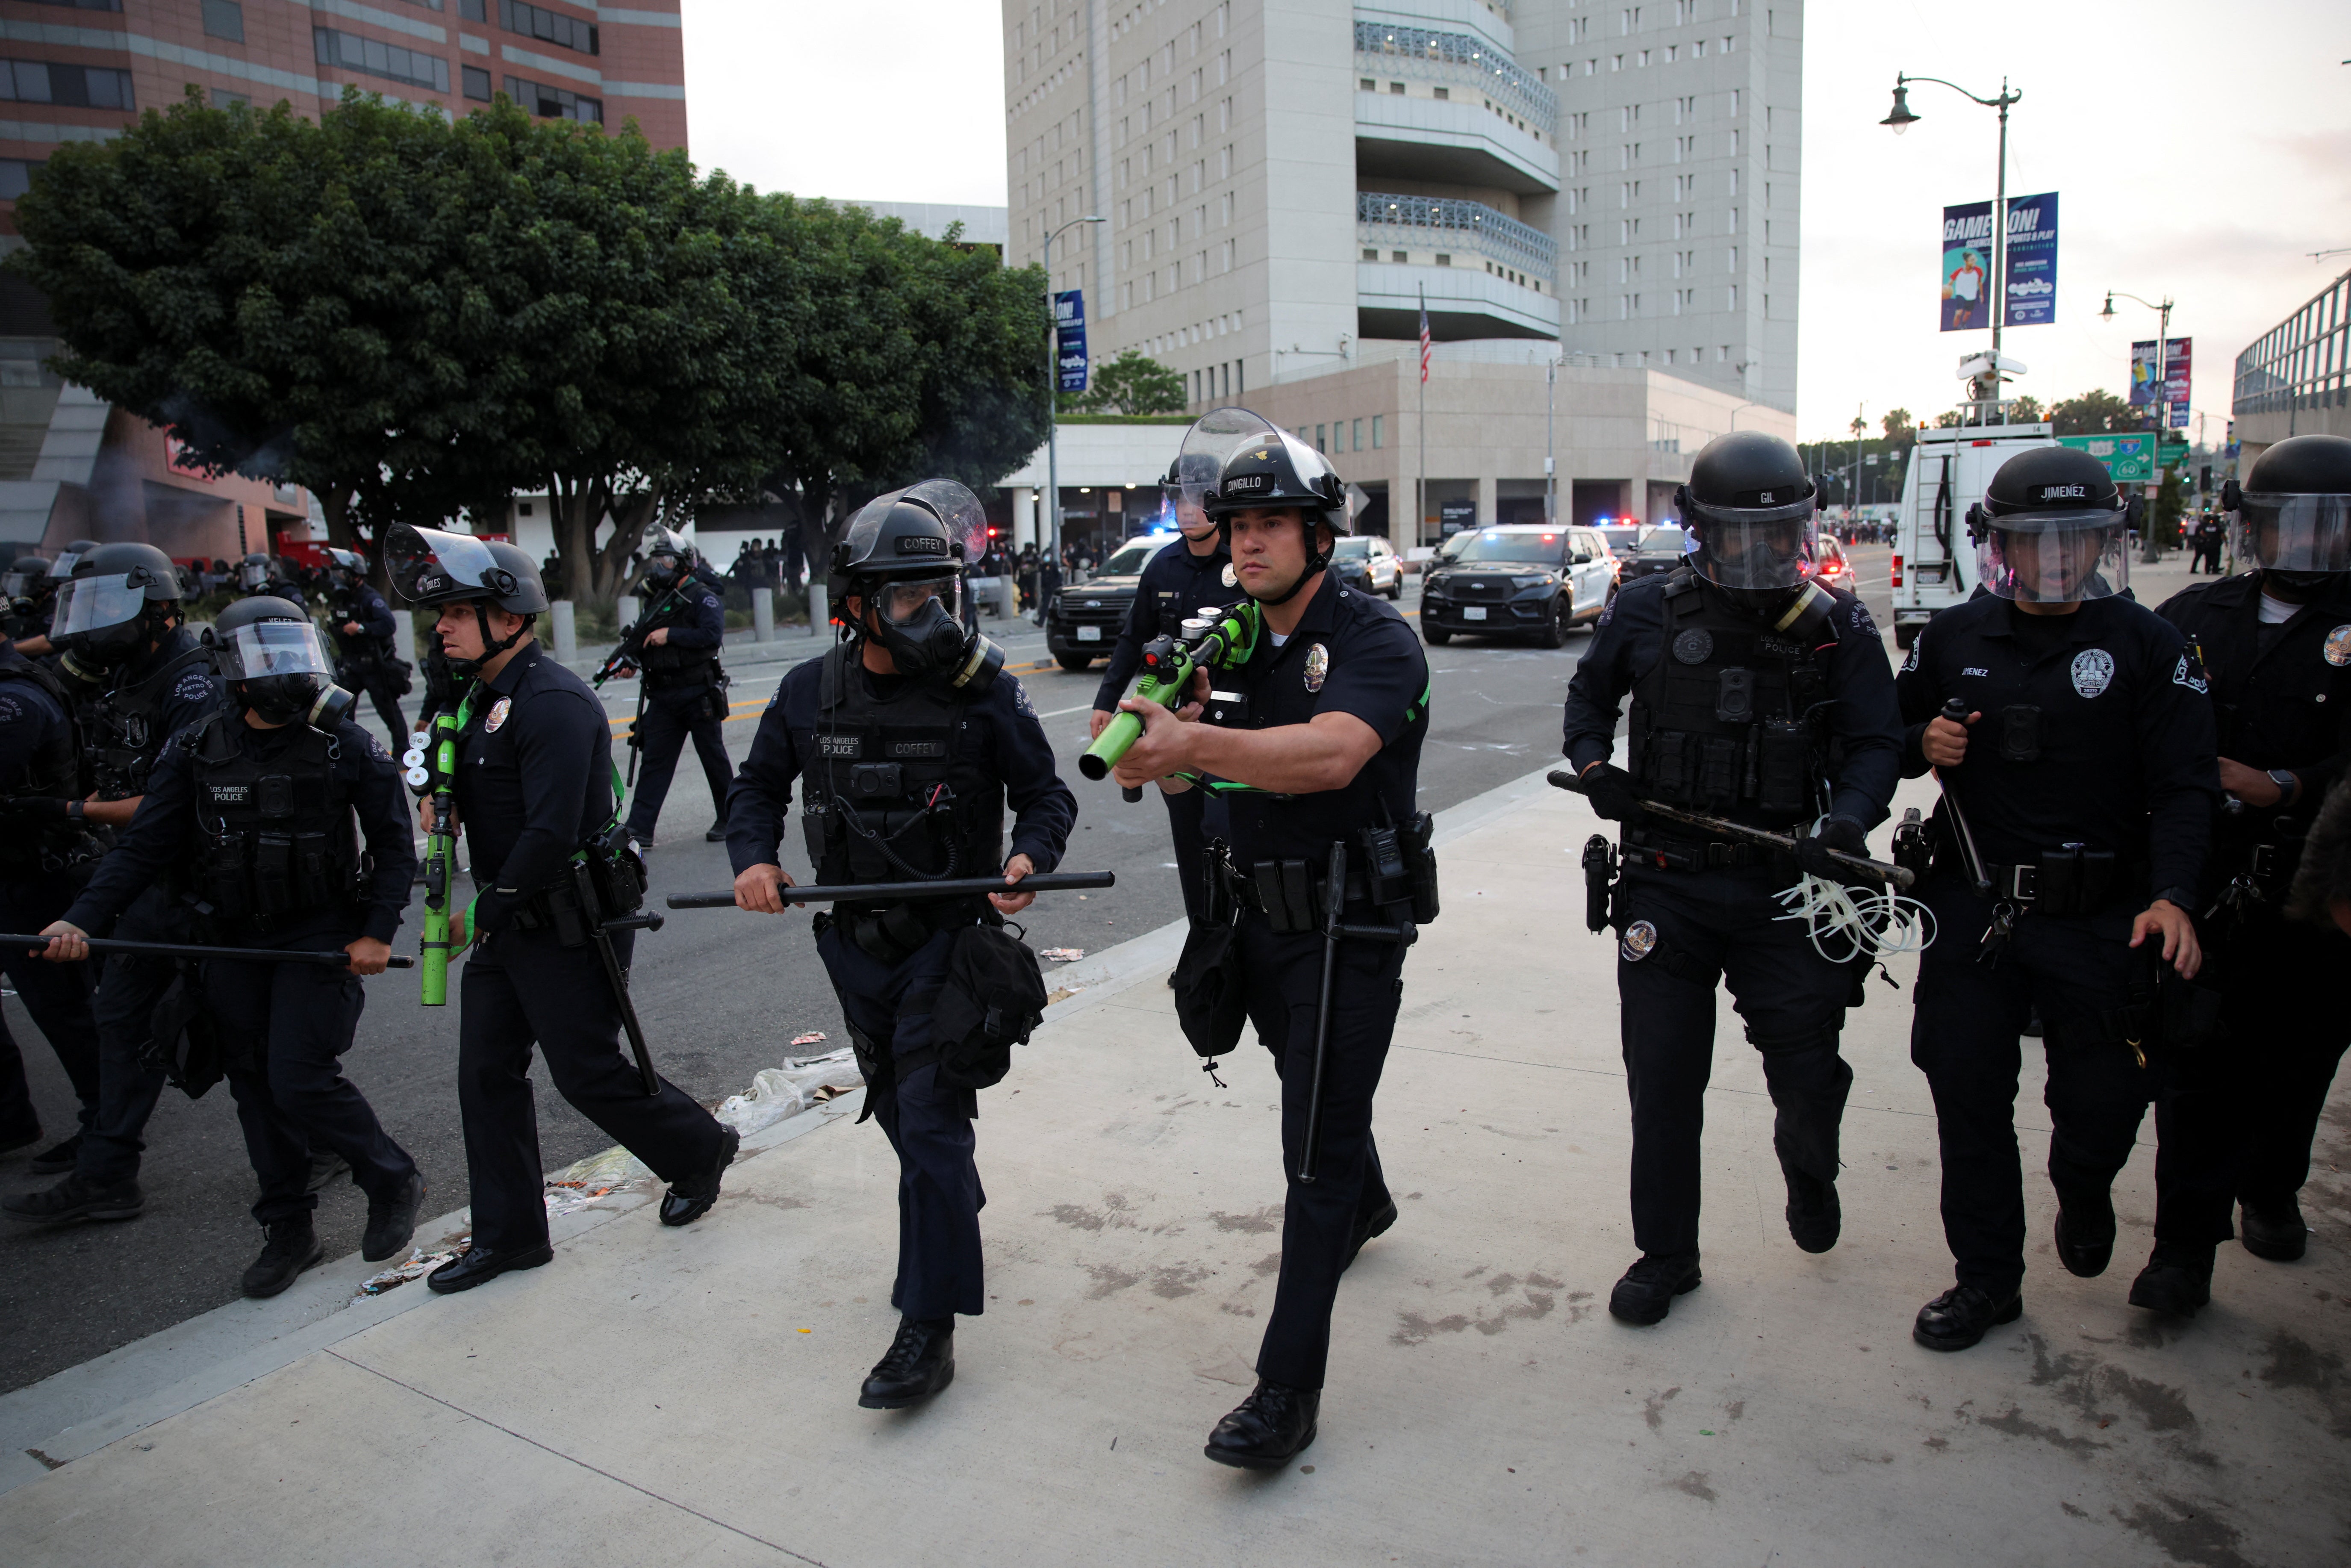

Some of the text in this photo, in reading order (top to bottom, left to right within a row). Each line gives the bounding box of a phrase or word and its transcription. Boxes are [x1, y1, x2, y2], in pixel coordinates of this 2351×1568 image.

[1944, 207, 2040, 242] GAME ON!
[2127, 444, 2133, 453] 5
[2121, 465, 2136, 474] 60
[1228, 477, 1261, 492] DINGILLO
[1761, 492, 1775, 503] GIL
[2041, 486, 2085, 499] JIMENEZ
[904, 538, 940, 550] COFFEY
[1852, 611, 1860, 628] LOS
[1688, 642, 1697, 651] C
[1909, 636, 1919, 668] GELES
[1678, 653, 1705, 662] DIVISION
[2078, 652, 2108, 663] POLICE OFFICER
[1962, 667, 1988, 677] JIMENEZ
[174, 675, 214, 697] LOS ANGELES
[183, 683, 205, 692] METRO
[184, 690, 209, 700] POLICE
[896, 742, 937, 755] COFFEY
